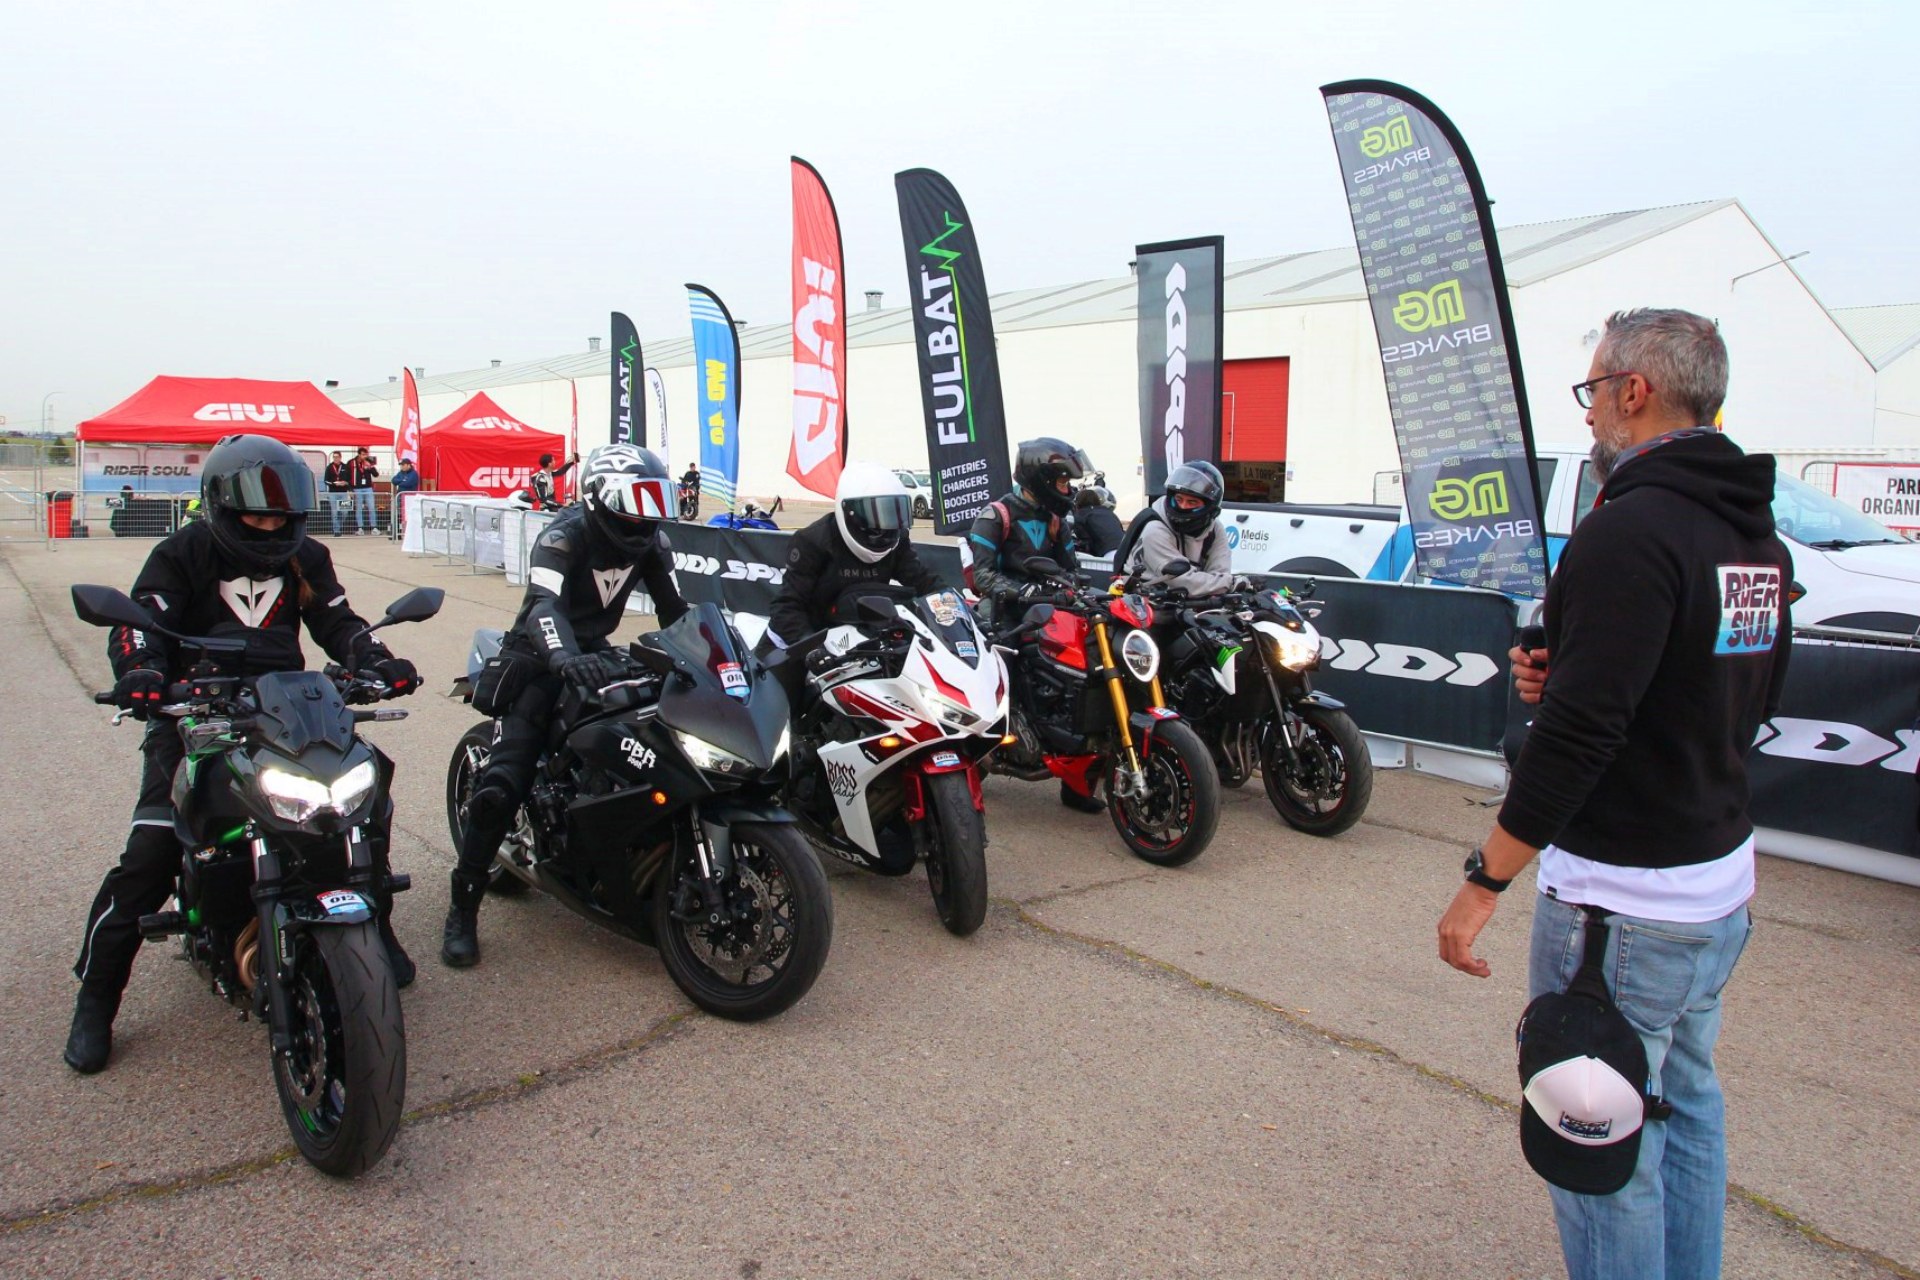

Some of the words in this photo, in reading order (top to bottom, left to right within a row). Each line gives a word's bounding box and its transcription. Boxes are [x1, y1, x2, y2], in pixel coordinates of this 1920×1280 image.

[921, 271, 968, 446] FULBAT
[618, 362, 632, 444] ULBAT
[193, 403, 293, 423] GIVI
[462, 416, 523, 432] GIVI
[103, 466, 149, 476] RIDER
[152, 466, 192, 476] SOUL
[469, 467, 531, 489] GIVI
[941, 459, 987, 479] BATTERIES
[942, 475, 989, 494] CHARGERS
[1887, 478, 1920, 495] PAR
[944, 490, 990, 509] BOOSTERS
[422, 516, 466, 530] RIDE
[1241, 529, 1270, 541] Medis
[1240, 541, 1268, 552] Grupo
[620, 737, 657, 769] CBR
[827, 759, 858, 791] BOSS
